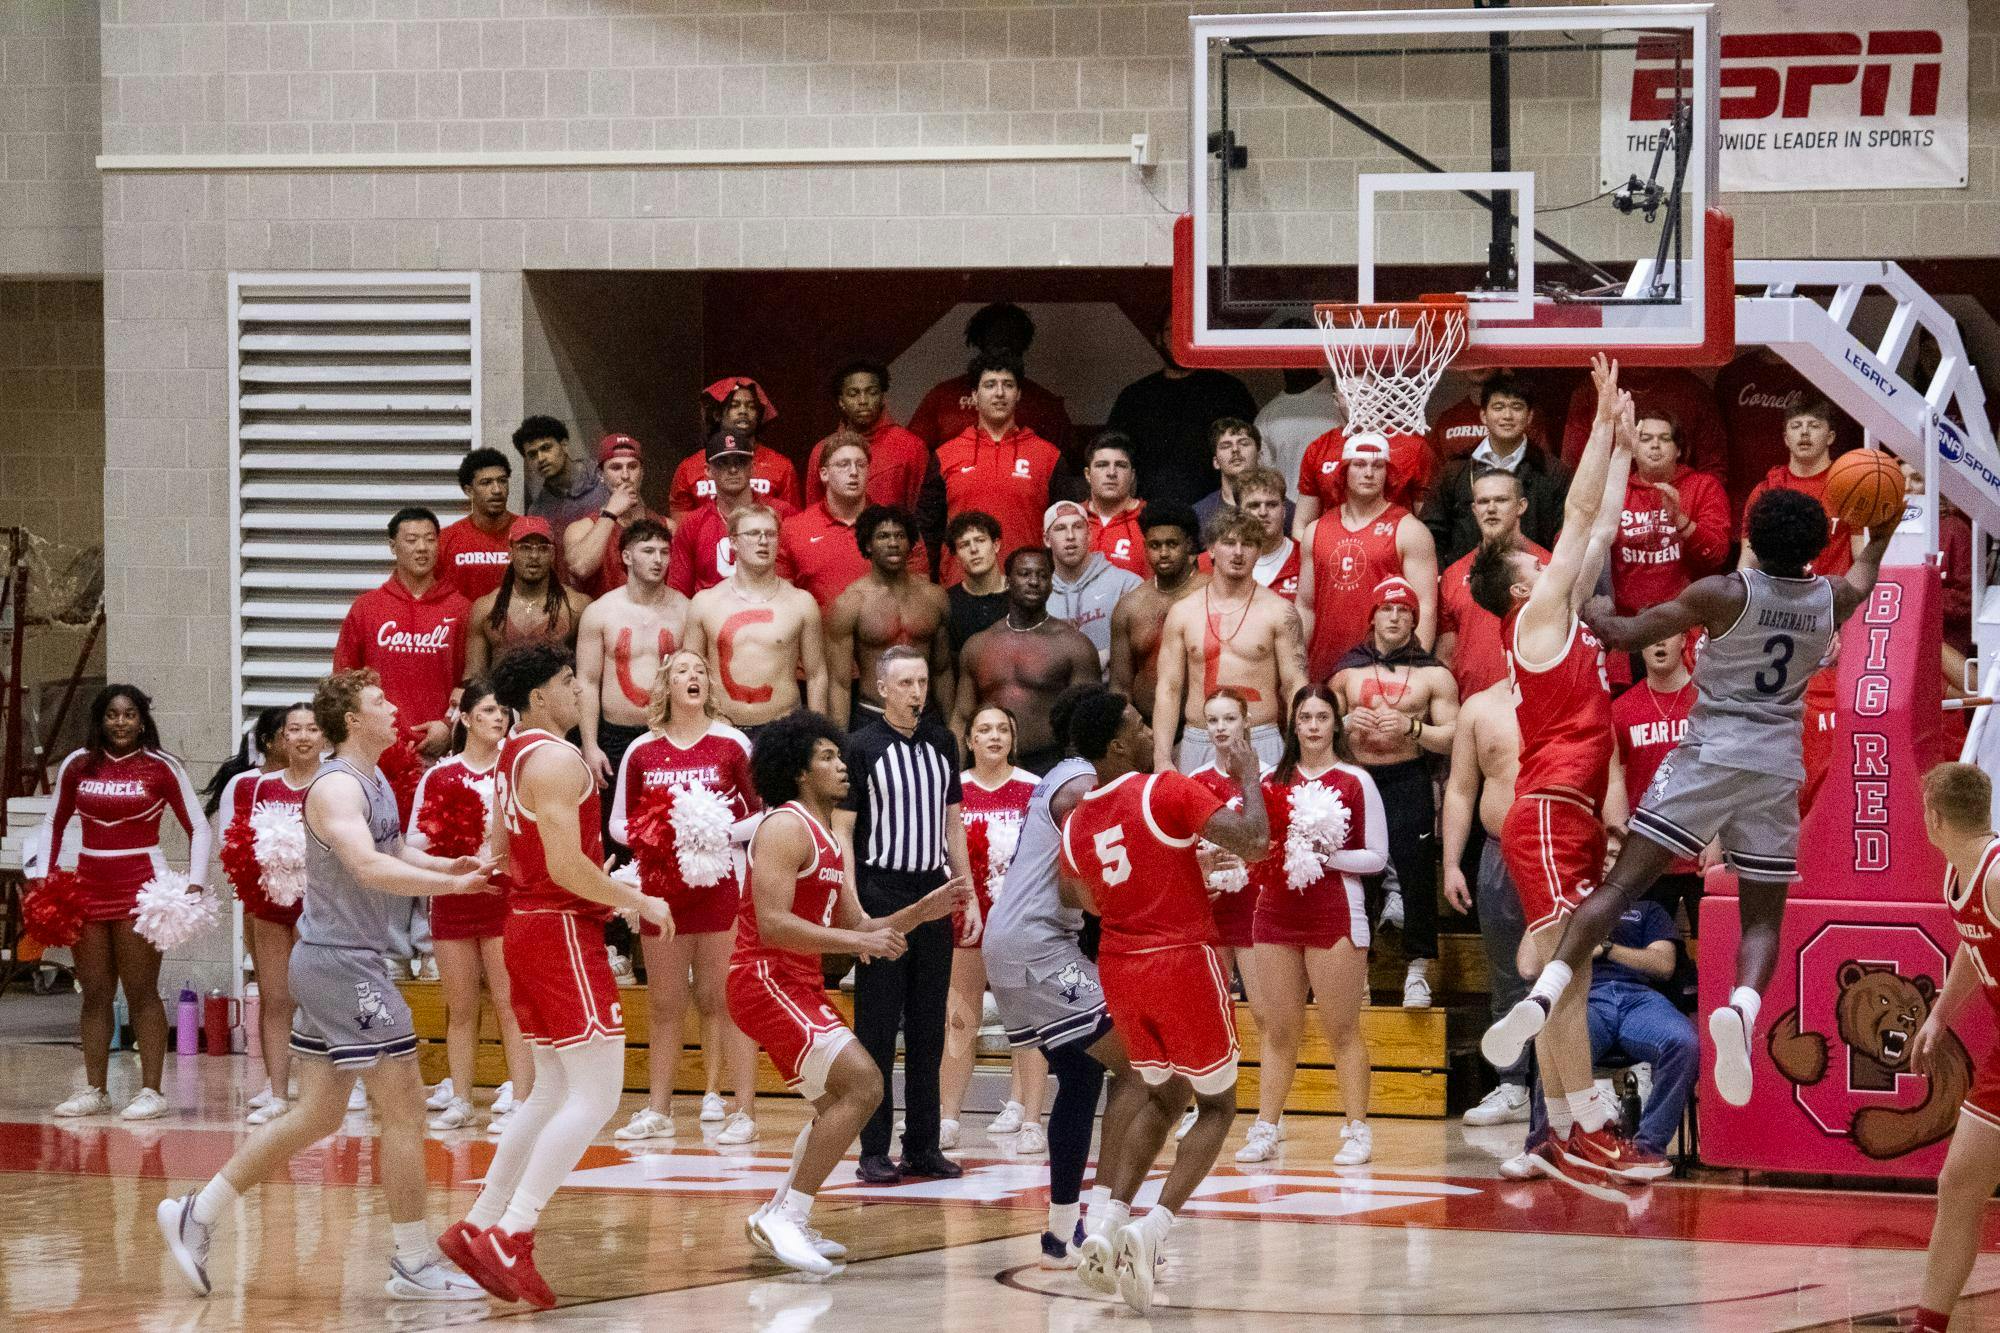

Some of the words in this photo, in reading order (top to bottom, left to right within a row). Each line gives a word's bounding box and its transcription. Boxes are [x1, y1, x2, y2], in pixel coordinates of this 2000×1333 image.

[1630, 30, 1943, 121] ESPN
[1626, 134, 1658, 151] THE
[1774, 130, 1838, 150] LEADER
[1844, 130, 1862, 147] IN
[1867, 129, 1935, 147] SPORTS
[1843, 348, 1899, 397] LEGACY
[1015, 458, 1030, 474] C
[1373, 521, 1395, 537] 24
[1621, 542, 1680, 564] SIXTEEN
[1757, 608, 1818, 633] BRATHWAITE
[376, 620, 450, 648] Cornell
[388, 645, 438, 654] FOOTBALL
[1853, 582, 1902, 717] BIG
[1755, 633, 1794, 694] 3
[1630, 720, 1670, 747] WEAR
[79, 779, 146, 797] CORNELL
[645, 766, 720, 785] CORNELL
[1853, 733, 1889, 871] RED
[1092, 823, 1133, 887] 5
